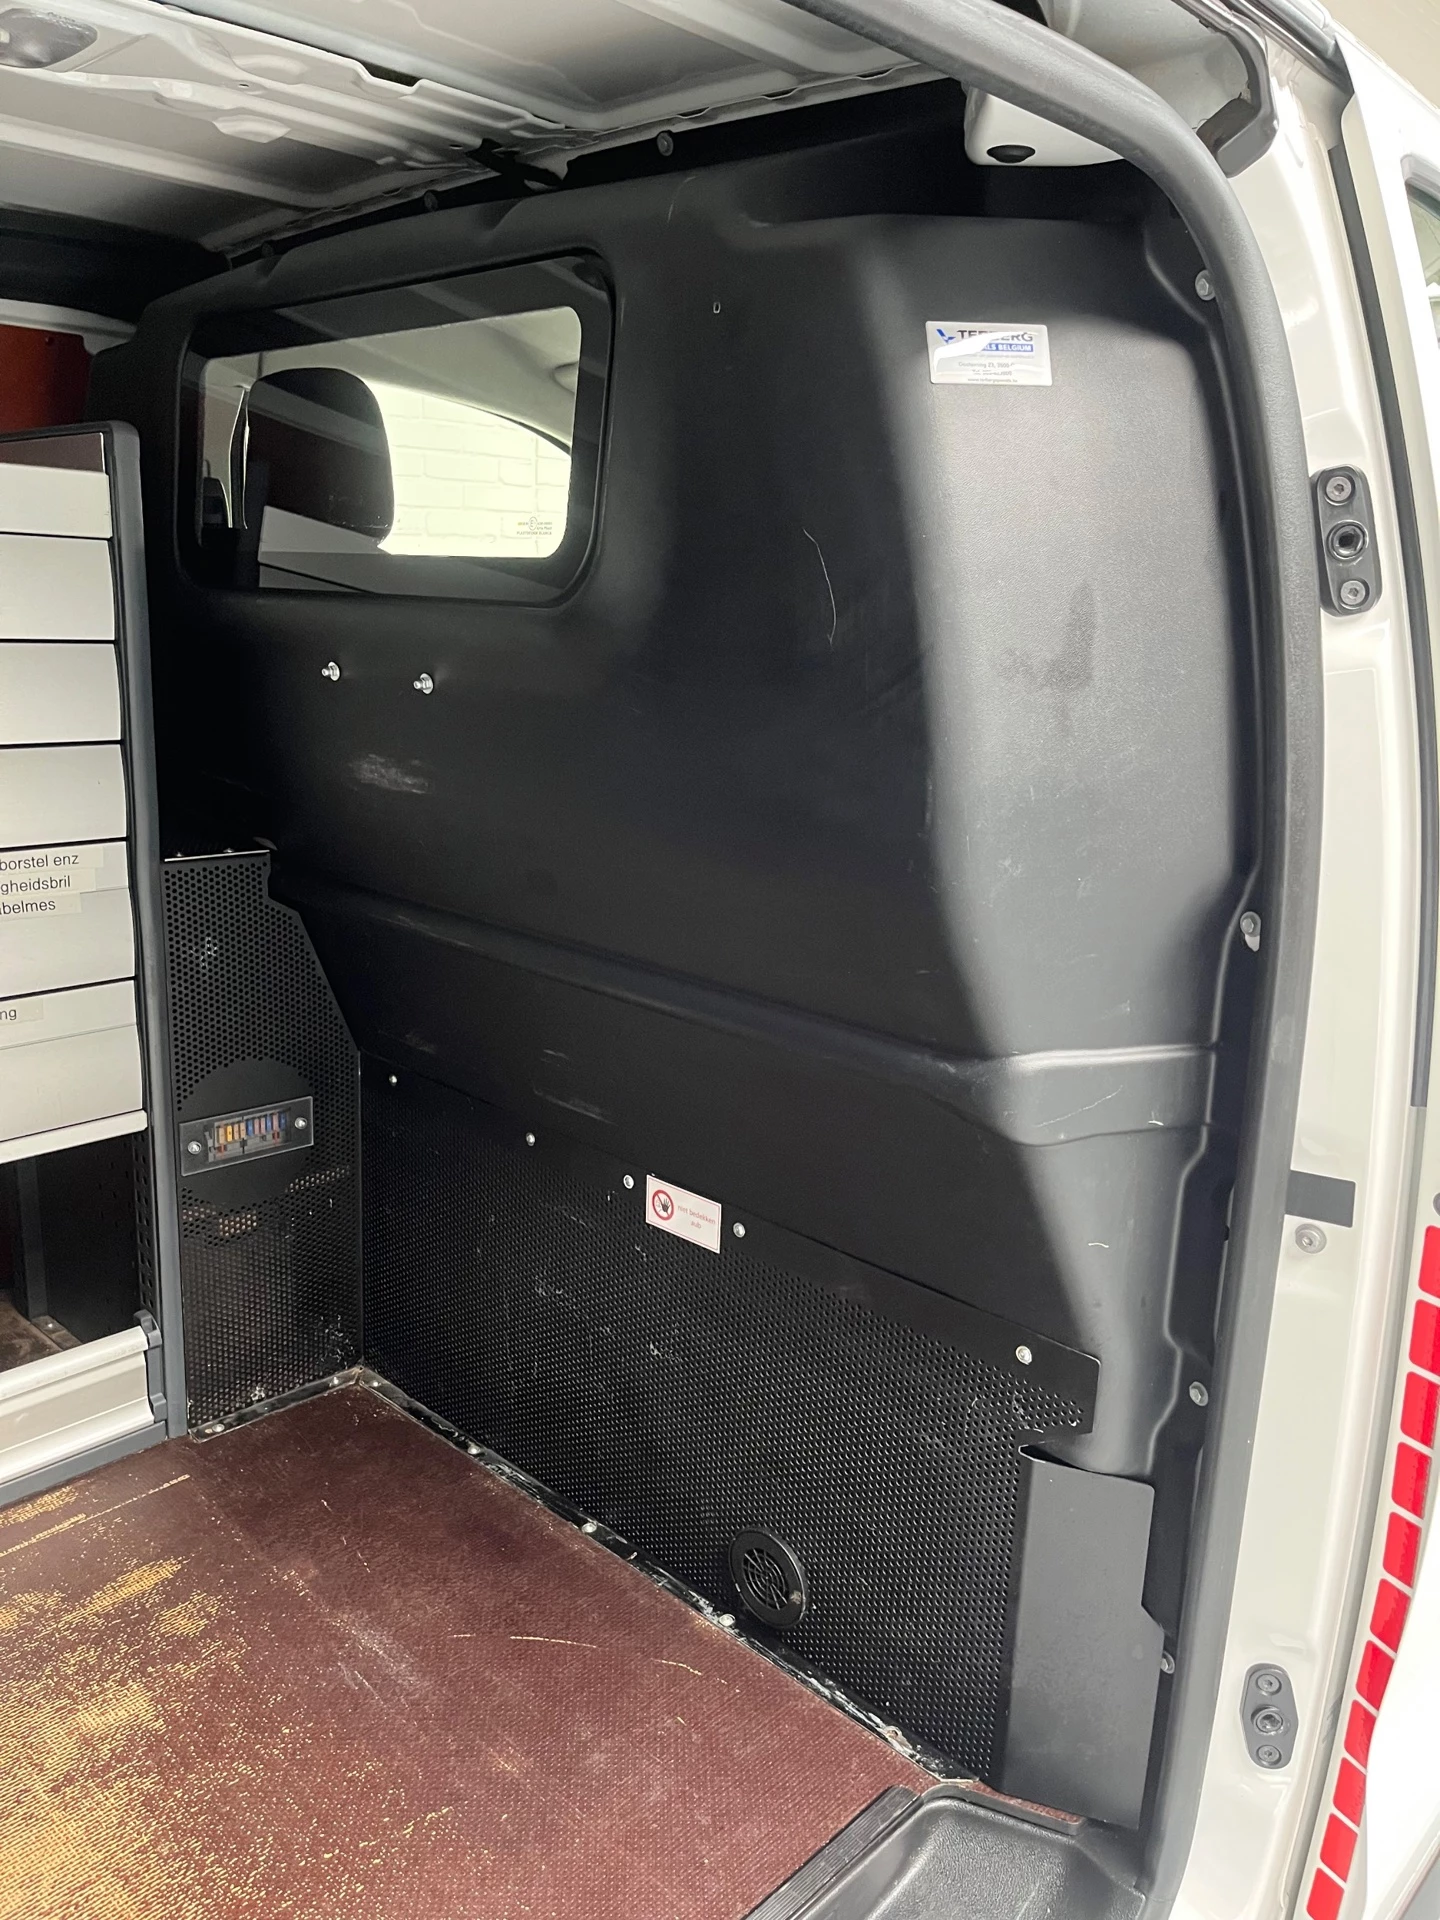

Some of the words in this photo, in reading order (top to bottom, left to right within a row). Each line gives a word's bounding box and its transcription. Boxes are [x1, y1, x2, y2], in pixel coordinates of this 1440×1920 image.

[998, 344, 1032, 352] BELGIUM
[0, 854, 49, 871] borstel
[53, 855, 80, 866] enz
[0, 875, 71, 895] gheidsbril
[0, 900, 56, 916] belmes
[689, 1208, 716, 1225] bedekken
